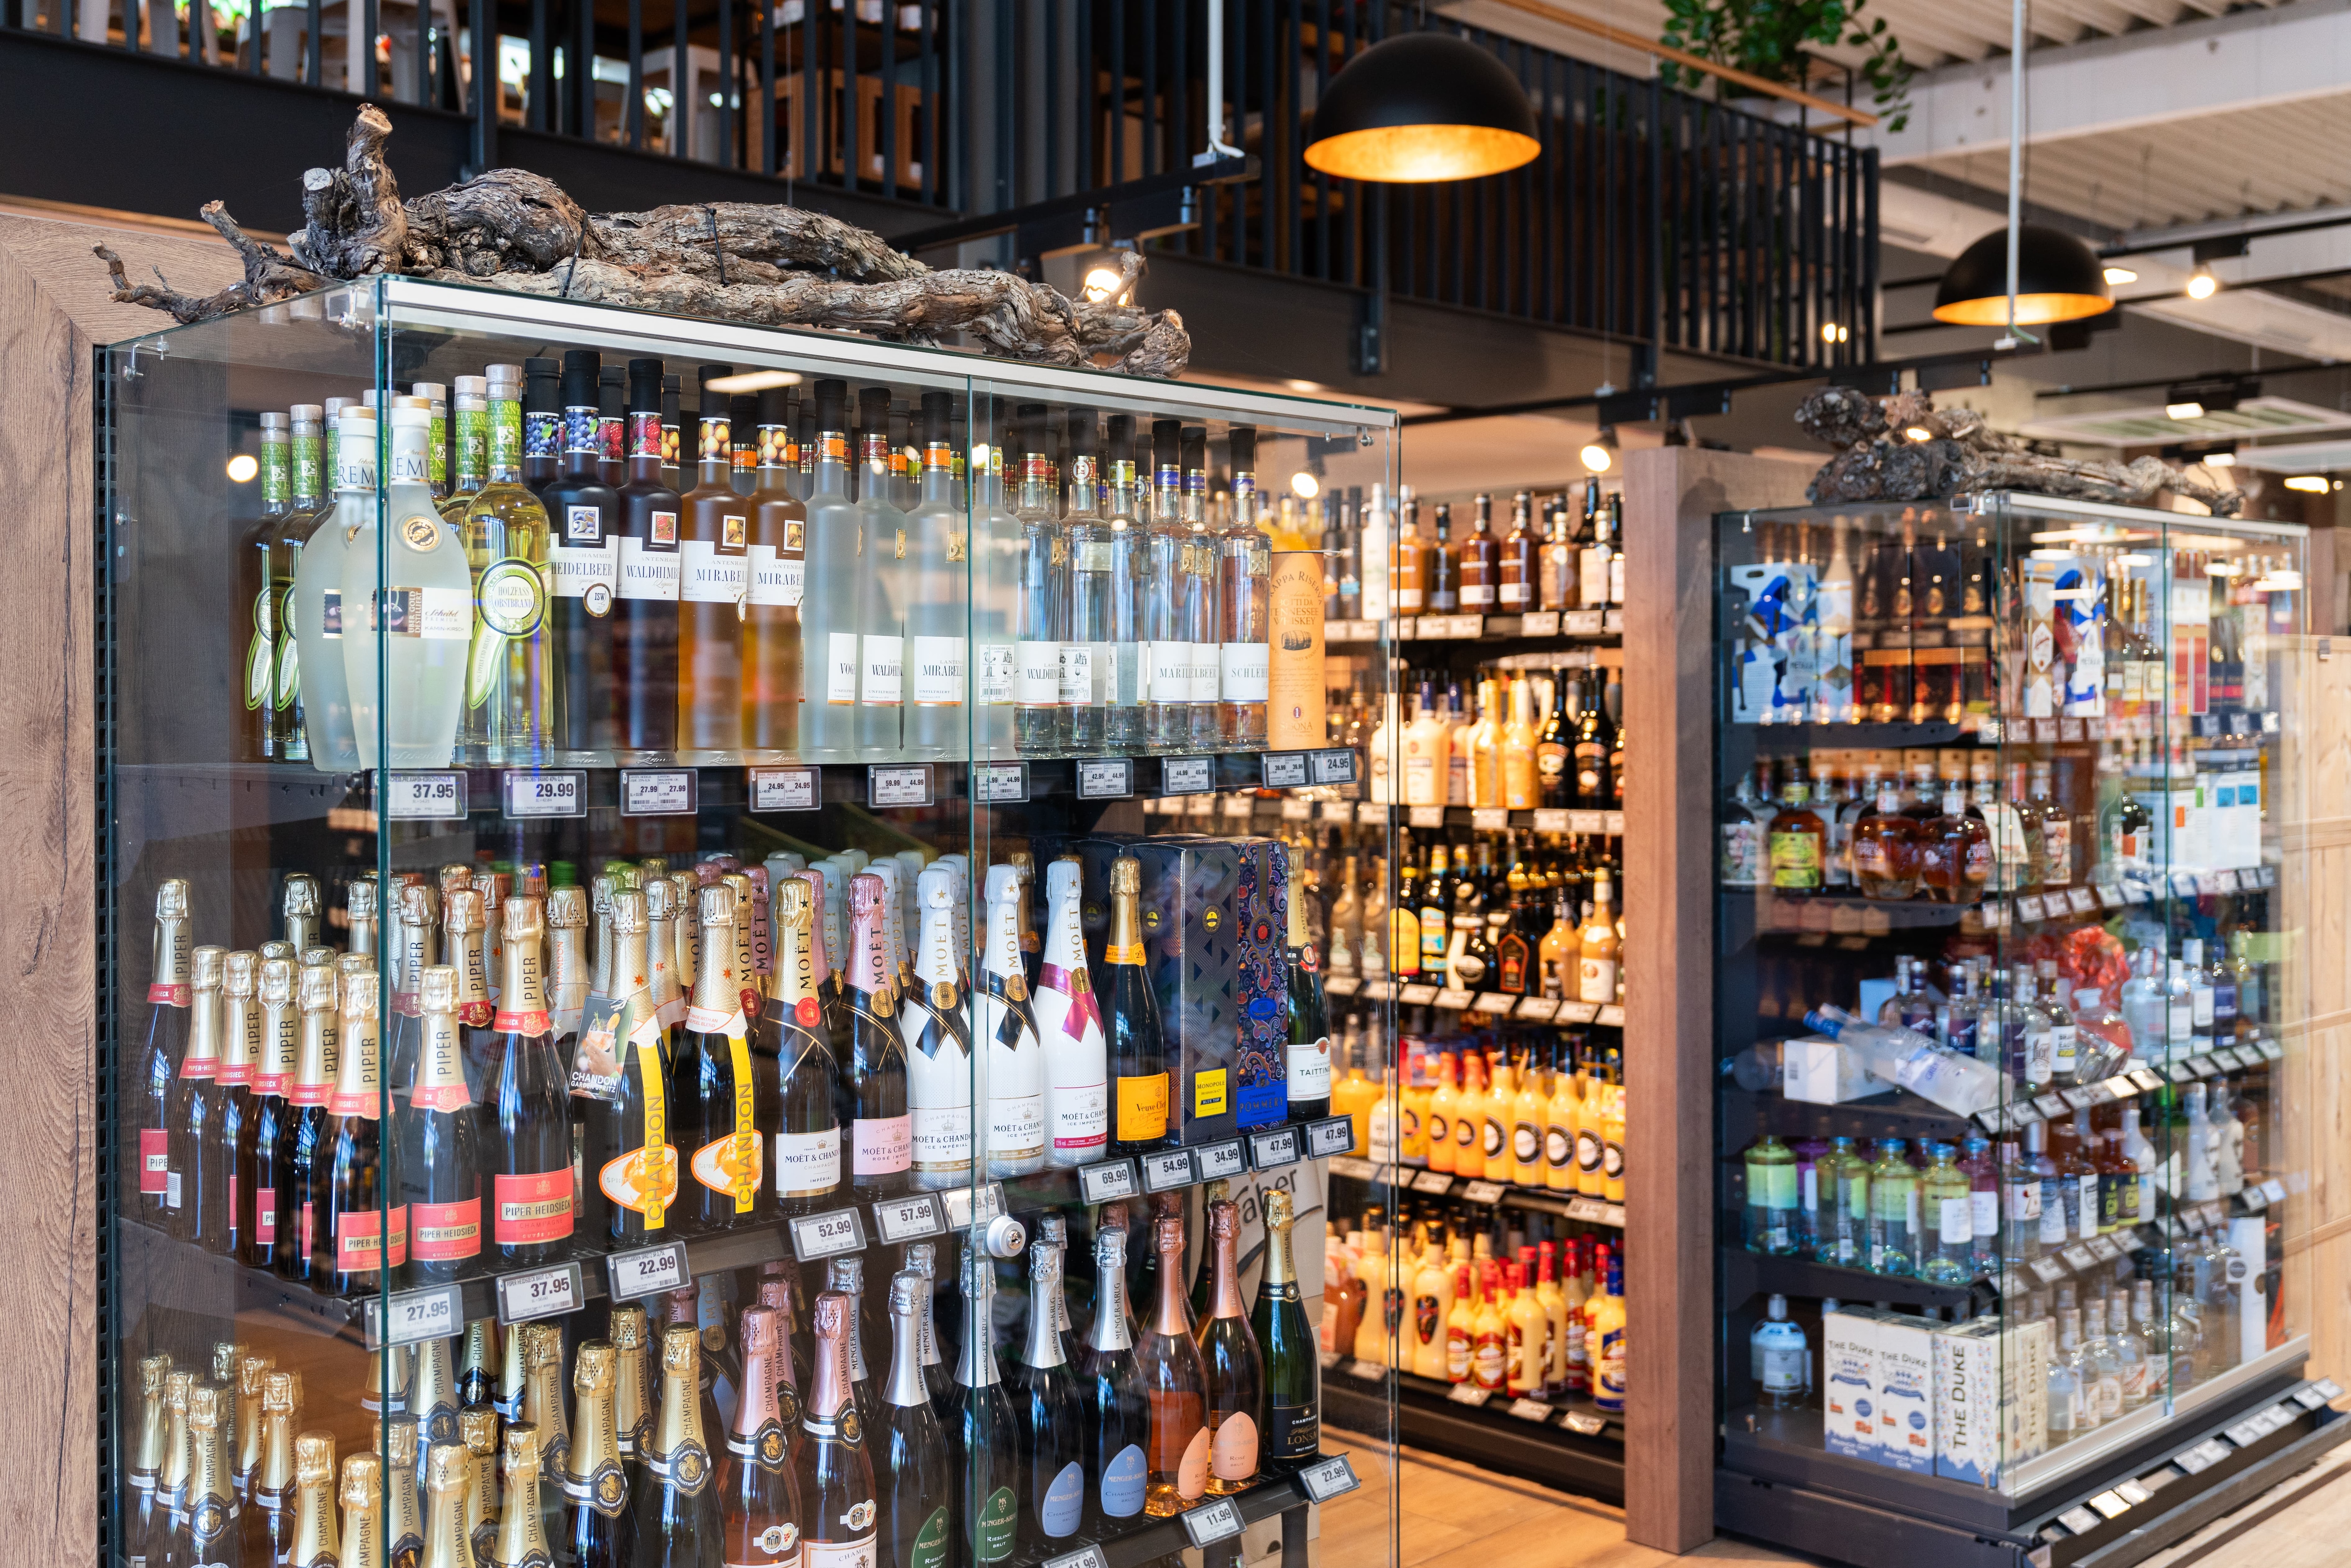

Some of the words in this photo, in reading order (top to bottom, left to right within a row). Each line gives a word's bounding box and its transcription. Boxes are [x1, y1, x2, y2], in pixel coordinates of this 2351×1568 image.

[552, 562, 612, 576] HEIDELBEER
[498, 587, 529, 596] HOLZFASS
[594, 592, 605, 601] ISW
[495, 599, 532, 608] OBSTBRAND
[1270, 607, 1319, 616] TENNESSEE
[1274, 616, 1316, 625] WHISKEY
[1328, 758, 1349, 769] 24.95
[413, 784, 454, 798] 37.95
[536, 783, 574, 797] 29.99
[1298, 892, 1307, 935] TAITTINGER
[753, 915, 768, 970] MOËT
[1003, 914, 1019, 968] MOËT
[1067, 908, 1082, 961] MOËT
[174, 935, 187, 974] PIPER
[735, 923, 752, 982] MOËT
[795, 929, 812, 990] MOËT
[869, 928, 886, 985] MOËT
[409, 942, 424, 982] PIPER
[469, 949, 483, 991] PIPER
[555, 941, 564, 991] CHANDON
[523, 957, 537, 1000] PIPER
[248, 1012, 260, 1054] PIPER
[281, 1020, 295, 1063] PIPER
[323, 1028, 336, 1072] PIPER
[436, 1031, 452, 1075] PIPER
[362, 1038, 376, 1083] PIPER
[570, 1080, 595, 1090] GARDEN
[572, 1072, 617, 1087] CHANDON
[1197, 1080, 1225, 1090] MONOPOLE
[1239, 1096, 1283, 1113] POMMERY
[1062, 1111, 1083, 1120] MOËT
[994, 1122, 1017, 1132] MOËT
[1325, 1127, 1346, 1140] 47.99
[738, 1083, 752, 1205] CHANDON
[1270, 1137, 1293, 1151] 47.99
[647, 1095, 663, 1220] CHANDON
[785, 1154, 810, 1162] MOËT
[1215, 1148, 1238, 1163] 34.99
[804, 1161, 835, 1170] CHAMPAGNE
[1163, 1158, 1188, 1173] 54.99
[1102, 1169, 1128, 1184] 69.99
[505, 1199, 571, 1215] PIPER-HEIDSIECK
[900, 1205, 931, 1221] 57.99
[420, 1228, 477, 1238] PIPER-HEIDSIECK
[819, 1220, 852, 1237] 52.99
[617, 1255, 641, 1264] CHAND.GARDEN
[639, 1255, 675, 1275] 22.99
[517, 1276, 536, 1284] HEIDSIECK
[531, 1277, 569, 1297] 37.95
[407, 1300, 449, 1321] 27.95
[1049, 1297, 1059, 1355] MENGER-KRUG
[851, 1309, 859, 1370] MENGER-KRUG
[1828, 1340, 1846, 1351] THE
[1848, 1341, 1874, 1357] DUKE
[916, 1330, 925, 1391] MENGER-KRUG
[1880, 1351, 1899, 1360] THE
[1901, 1353, 1928, 1368] DUKE
[1952, 1346, 1966, 1403] DUKE
[764, 1356, 773, 1411] CHAMPAGNE
[683, 1378, 693, 1436] CHAMPAGNE
[602, 1398, 612, 1456] CHAMPAGNE
[1952, 1410, 1967, 1450] THE
[205, 1435, 217, 1488] CHAMPAGNE
[678, 1450, 689, 1459] GRAND
[677, 1475, 694, 1486] TRADITION
[695, 1471, 704, 1485] RÉSERVE
[1322, 1466, 1346, 1482] 22.99
[483, 1461, 491, 1514] CHAMPAGNE
[318, 1489, 328, 1546] CHAMPAGNE
[529, 1480, 538, 1542] CHAMPAGNE
[1206, 1509, 1232, 1527] 11.99
[195, 1529, 211, 1537] TRADITION
[212, 1524, 223, 1536] RÉSERVE
[455, 1497, 465, 1562] CHAMPAGNE
[987, 1532, 1011, 1542] RIESLING
[925, 1552, 946, 1564] RIESLING
